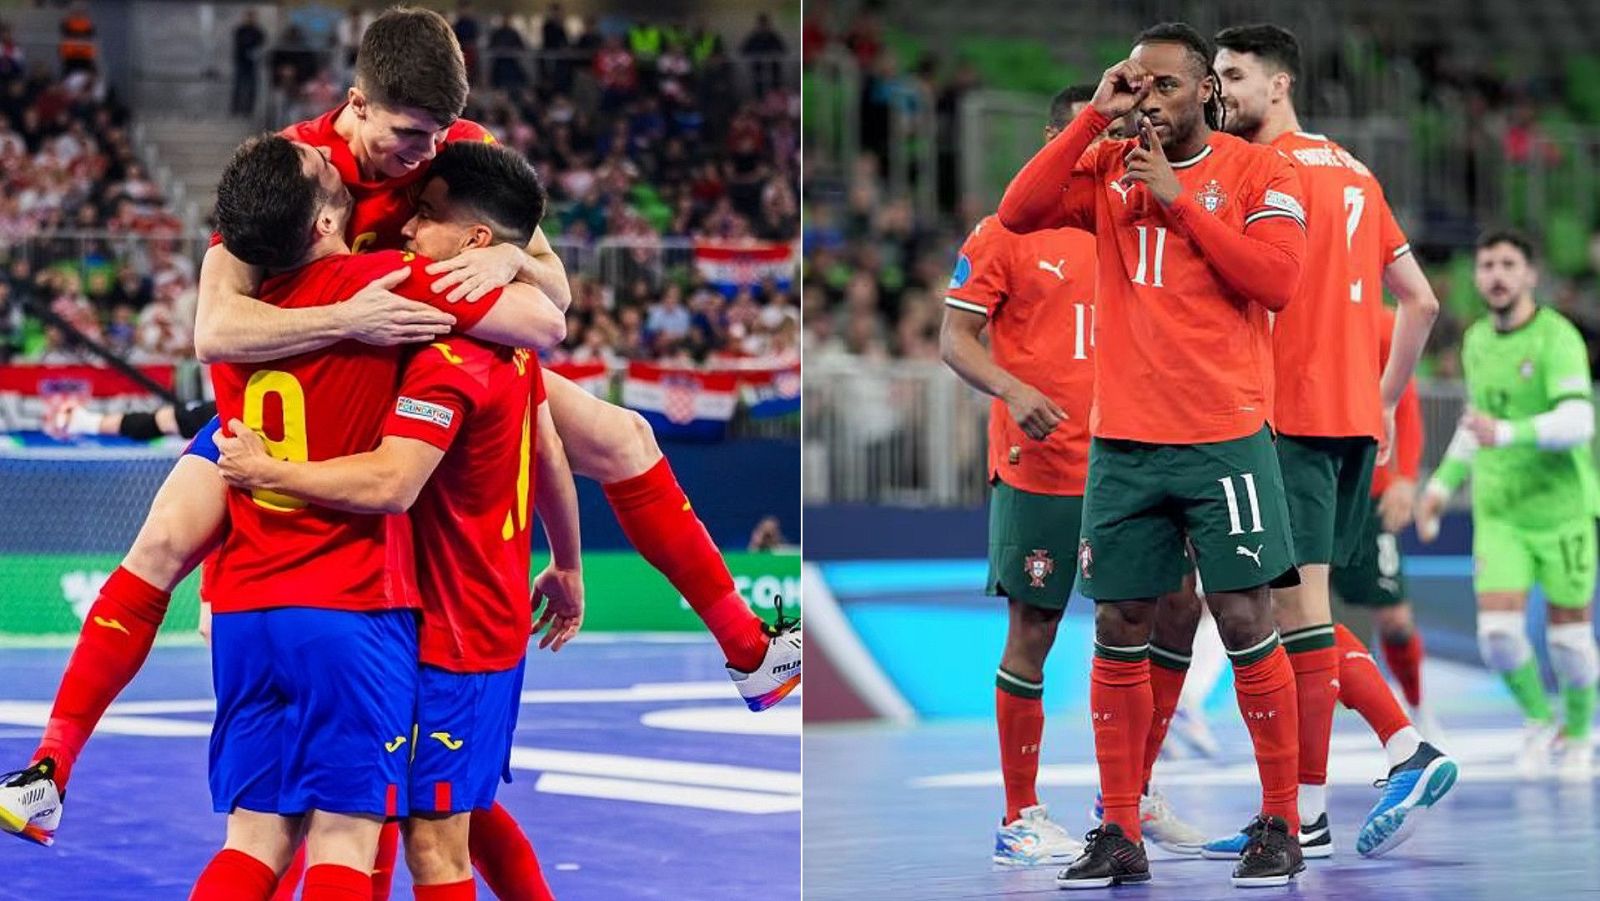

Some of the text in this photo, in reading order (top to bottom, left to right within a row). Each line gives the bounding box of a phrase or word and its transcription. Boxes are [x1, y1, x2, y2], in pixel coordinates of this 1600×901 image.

[1131, 226, 1166, 288] 11
[398, 402, 452, 421] FOUNDATION
[243, 369, 309, 512] 9
[1217, 473, 1265, 536] 11
[1377, 533, 1400, 578] 8
[1558, 534, 1589, 575] 12
